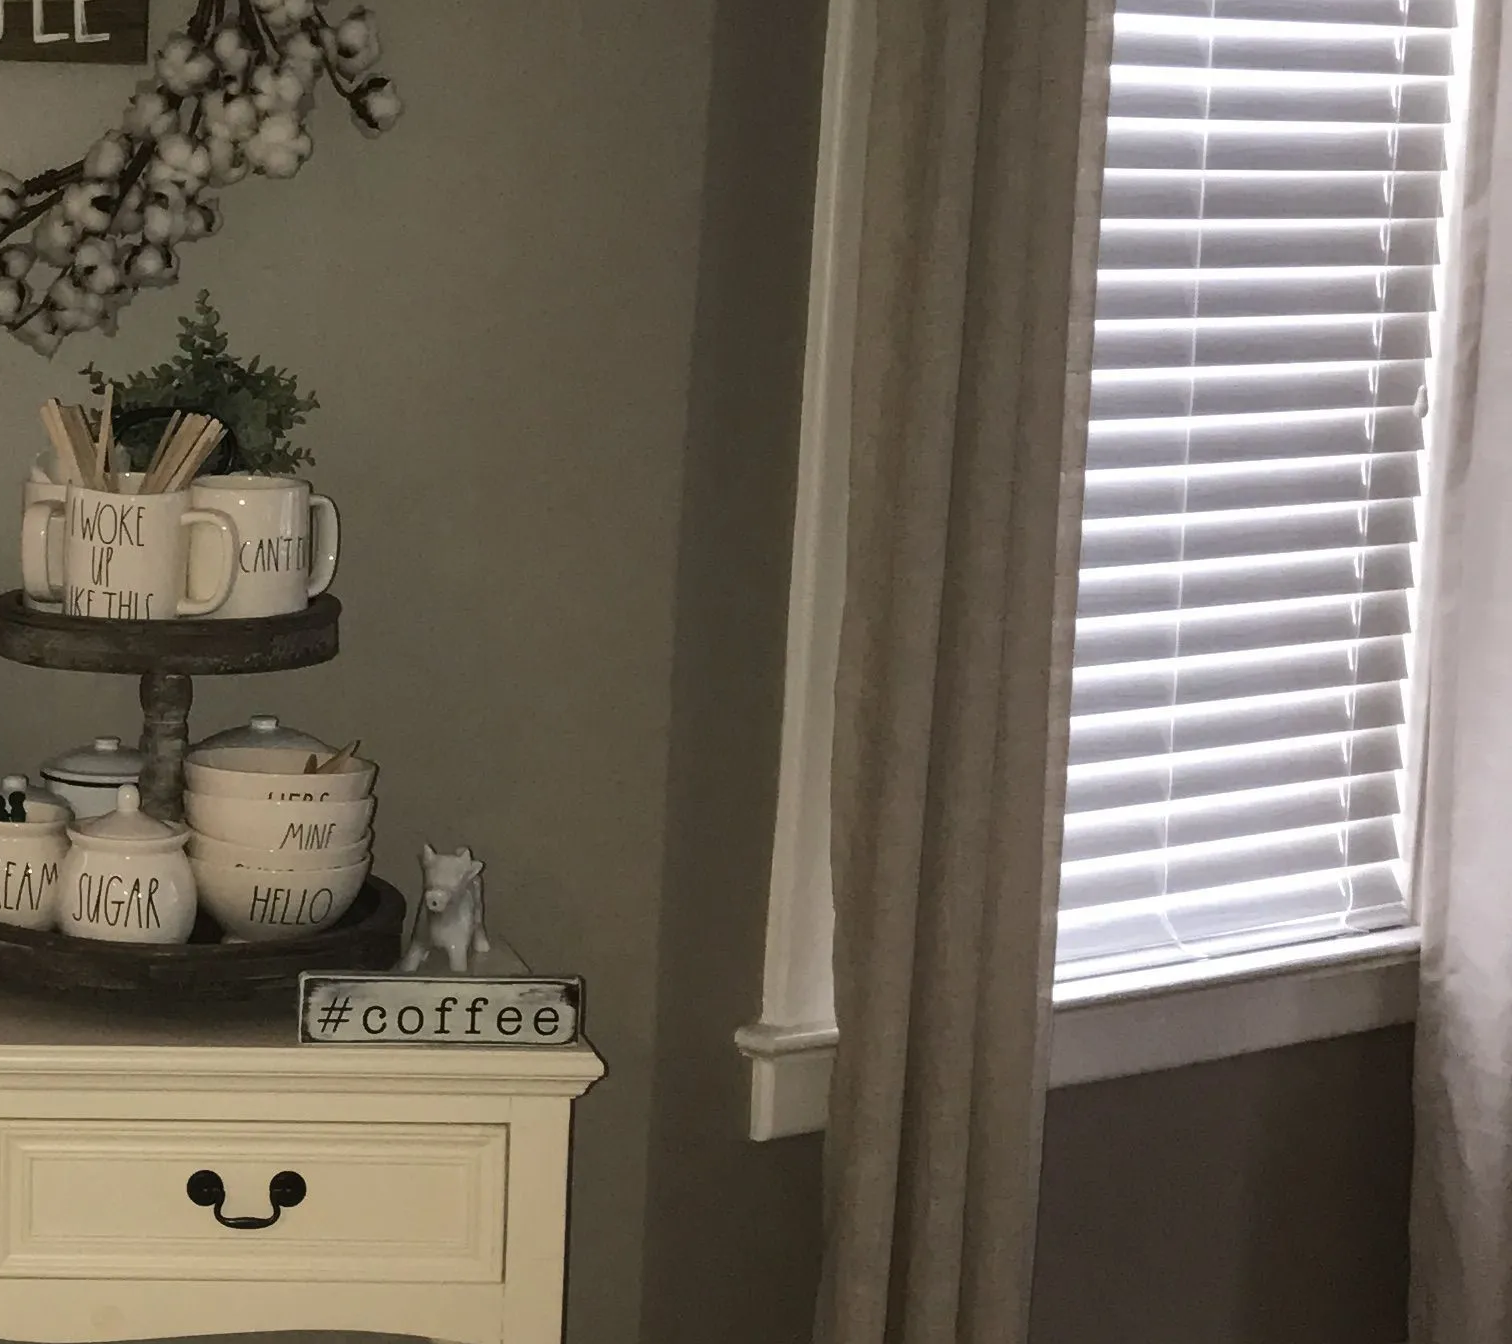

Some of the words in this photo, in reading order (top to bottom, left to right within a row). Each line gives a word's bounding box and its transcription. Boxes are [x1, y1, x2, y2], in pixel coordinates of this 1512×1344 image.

[80, 499, 146, 547] WOKE
[91, 546, 114, 588] UP
[72, 872, 161, 929] SUGAR
[250, 885, 334, 926] HELLO
[317, 996, 560, 1036] #coffee
